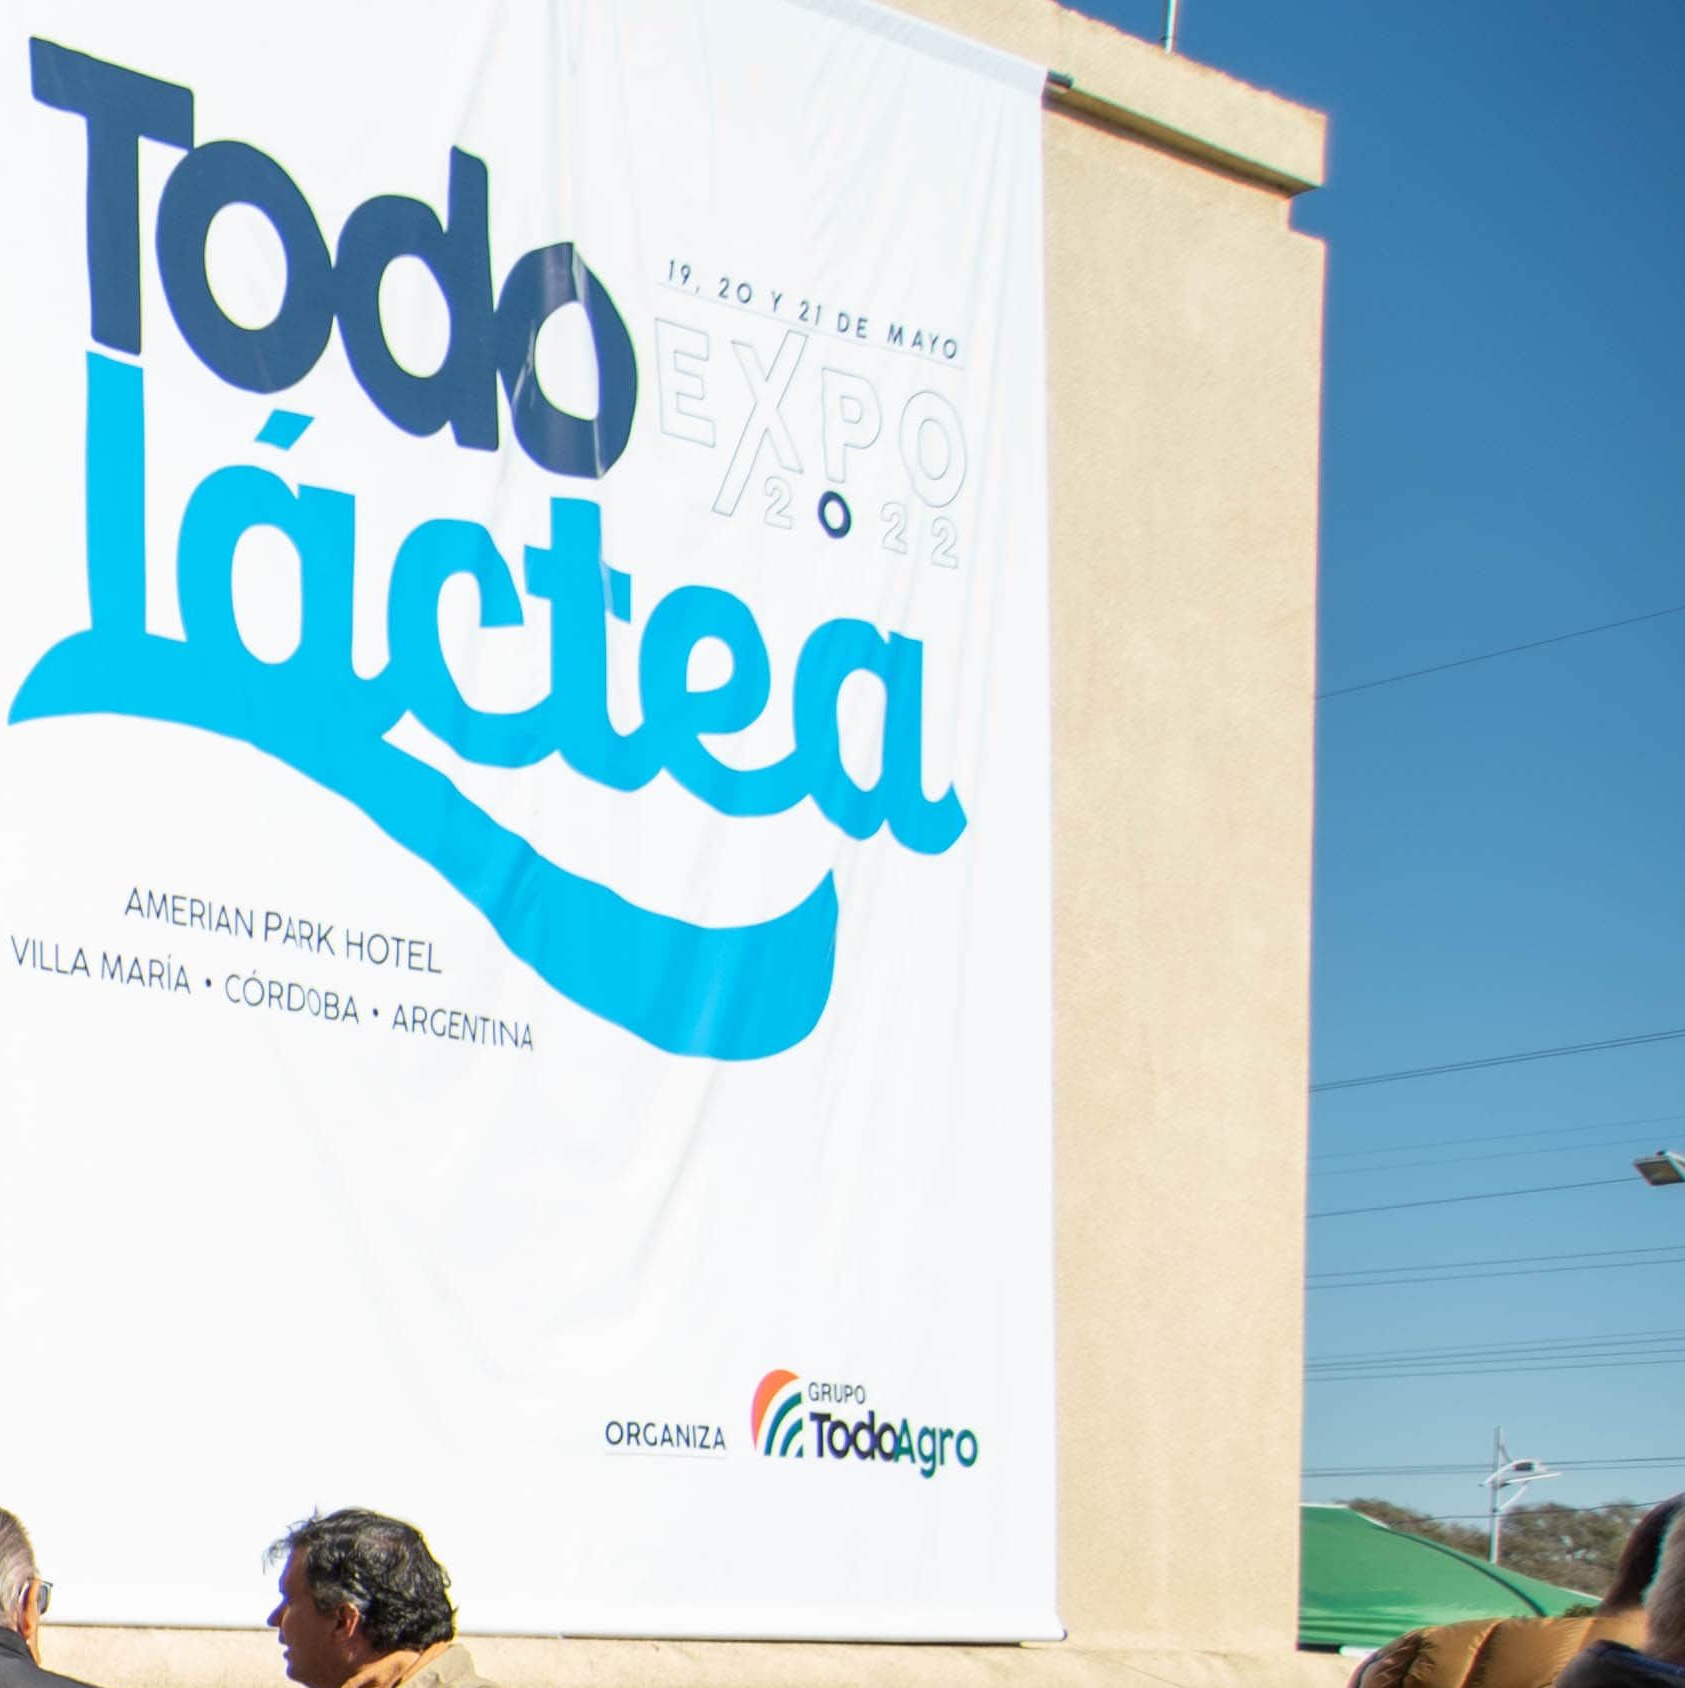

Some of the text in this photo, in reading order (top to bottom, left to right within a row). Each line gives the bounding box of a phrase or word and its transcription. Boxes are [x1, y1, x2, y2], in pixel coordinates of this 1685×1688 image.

[29, 36, 639, 480] Todo
[668, 260, 958, 360] 19, 20 Y 21 DE MAYO
[654, 317, 968, 518] EXPO
[125, 886, 443, 974] AMERIAN PARK HOTEL
[10, 936, 534, 1051] VILLA MARÍA CÓRDOBA ARGENTINA
[604, 1420, 726, 1451] ORGANIZA
[808, 1382, 866, 1405] GRUPO
[809, 1410, 979, 1479] TodoAgro
